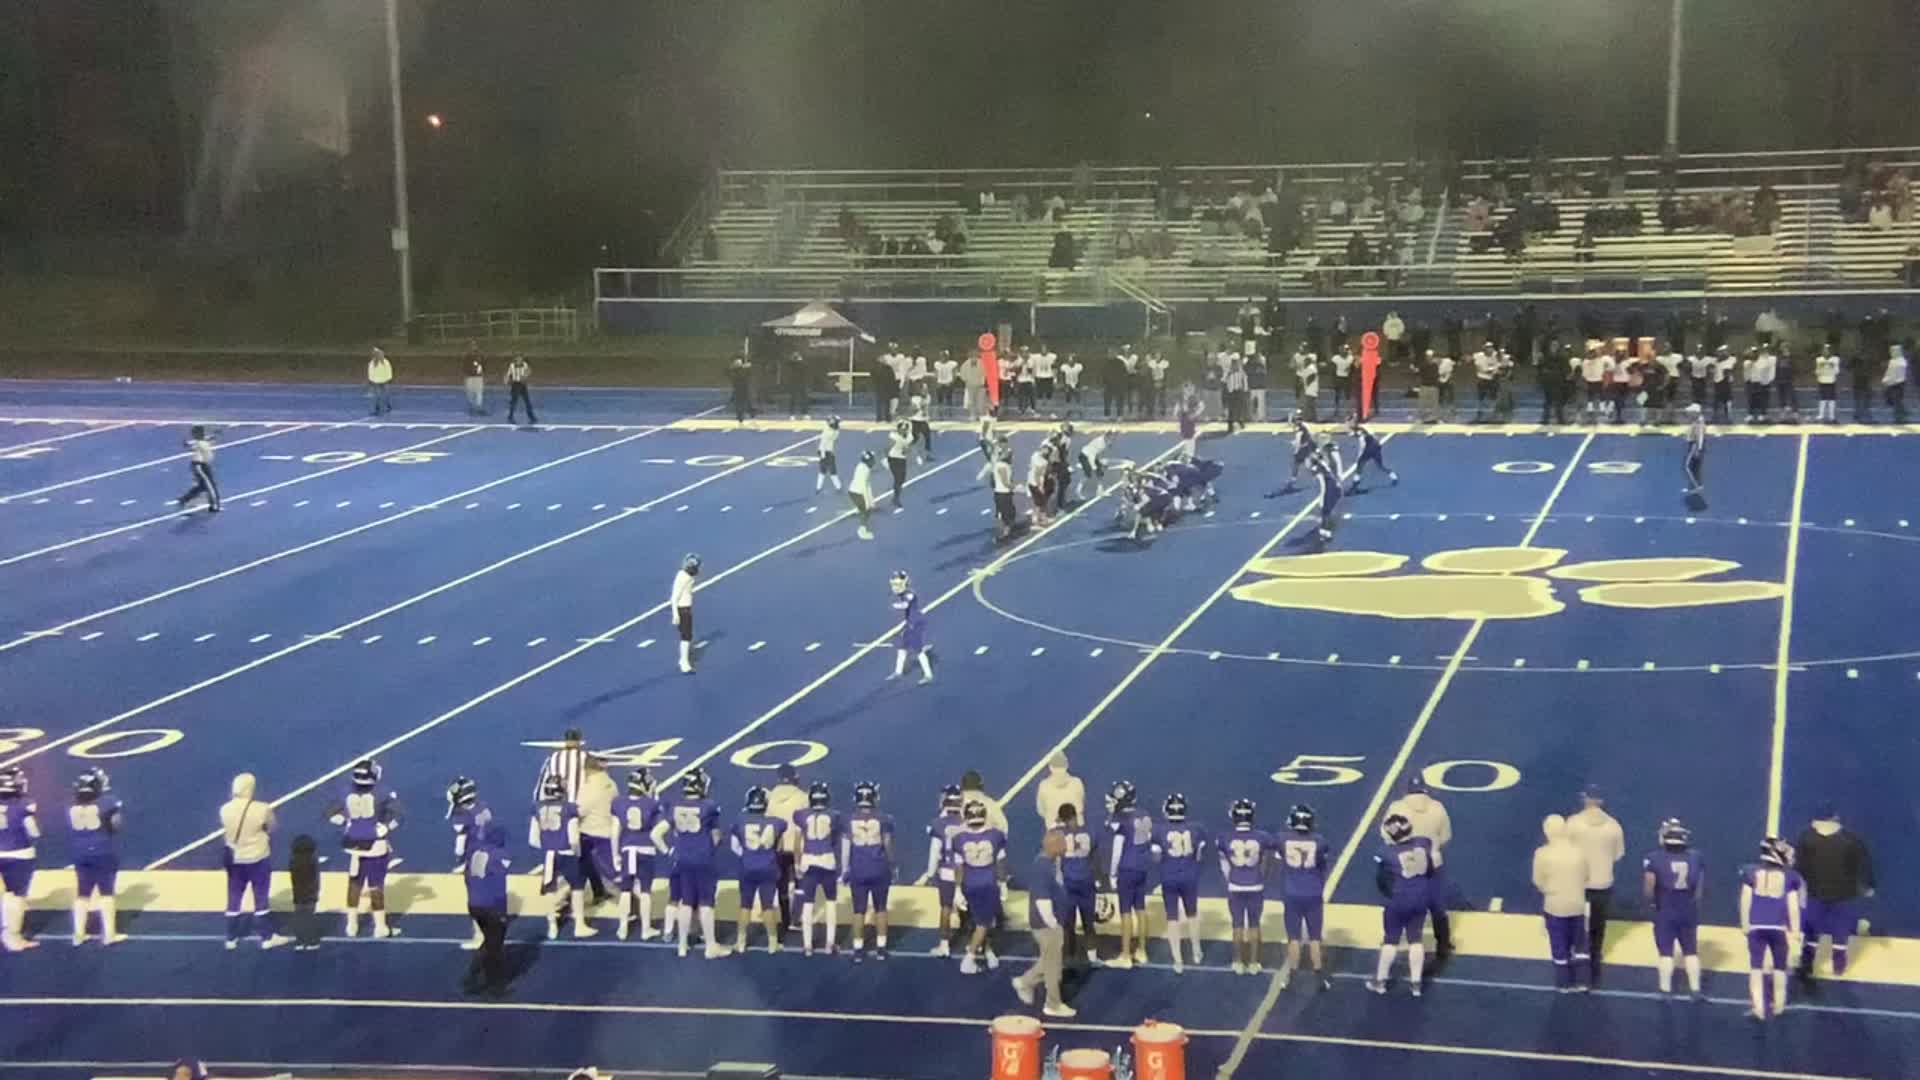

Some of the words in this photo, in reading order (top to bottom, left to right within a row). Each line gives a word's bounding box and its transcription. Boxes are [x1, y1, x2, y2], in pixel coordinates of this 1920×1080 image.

[1270, 755, 1521, 791] 50
[744, 822, 776, 851] 54
[1284, 840, 1317, 868] 57
[1671, 861, 1689, 890] 7
